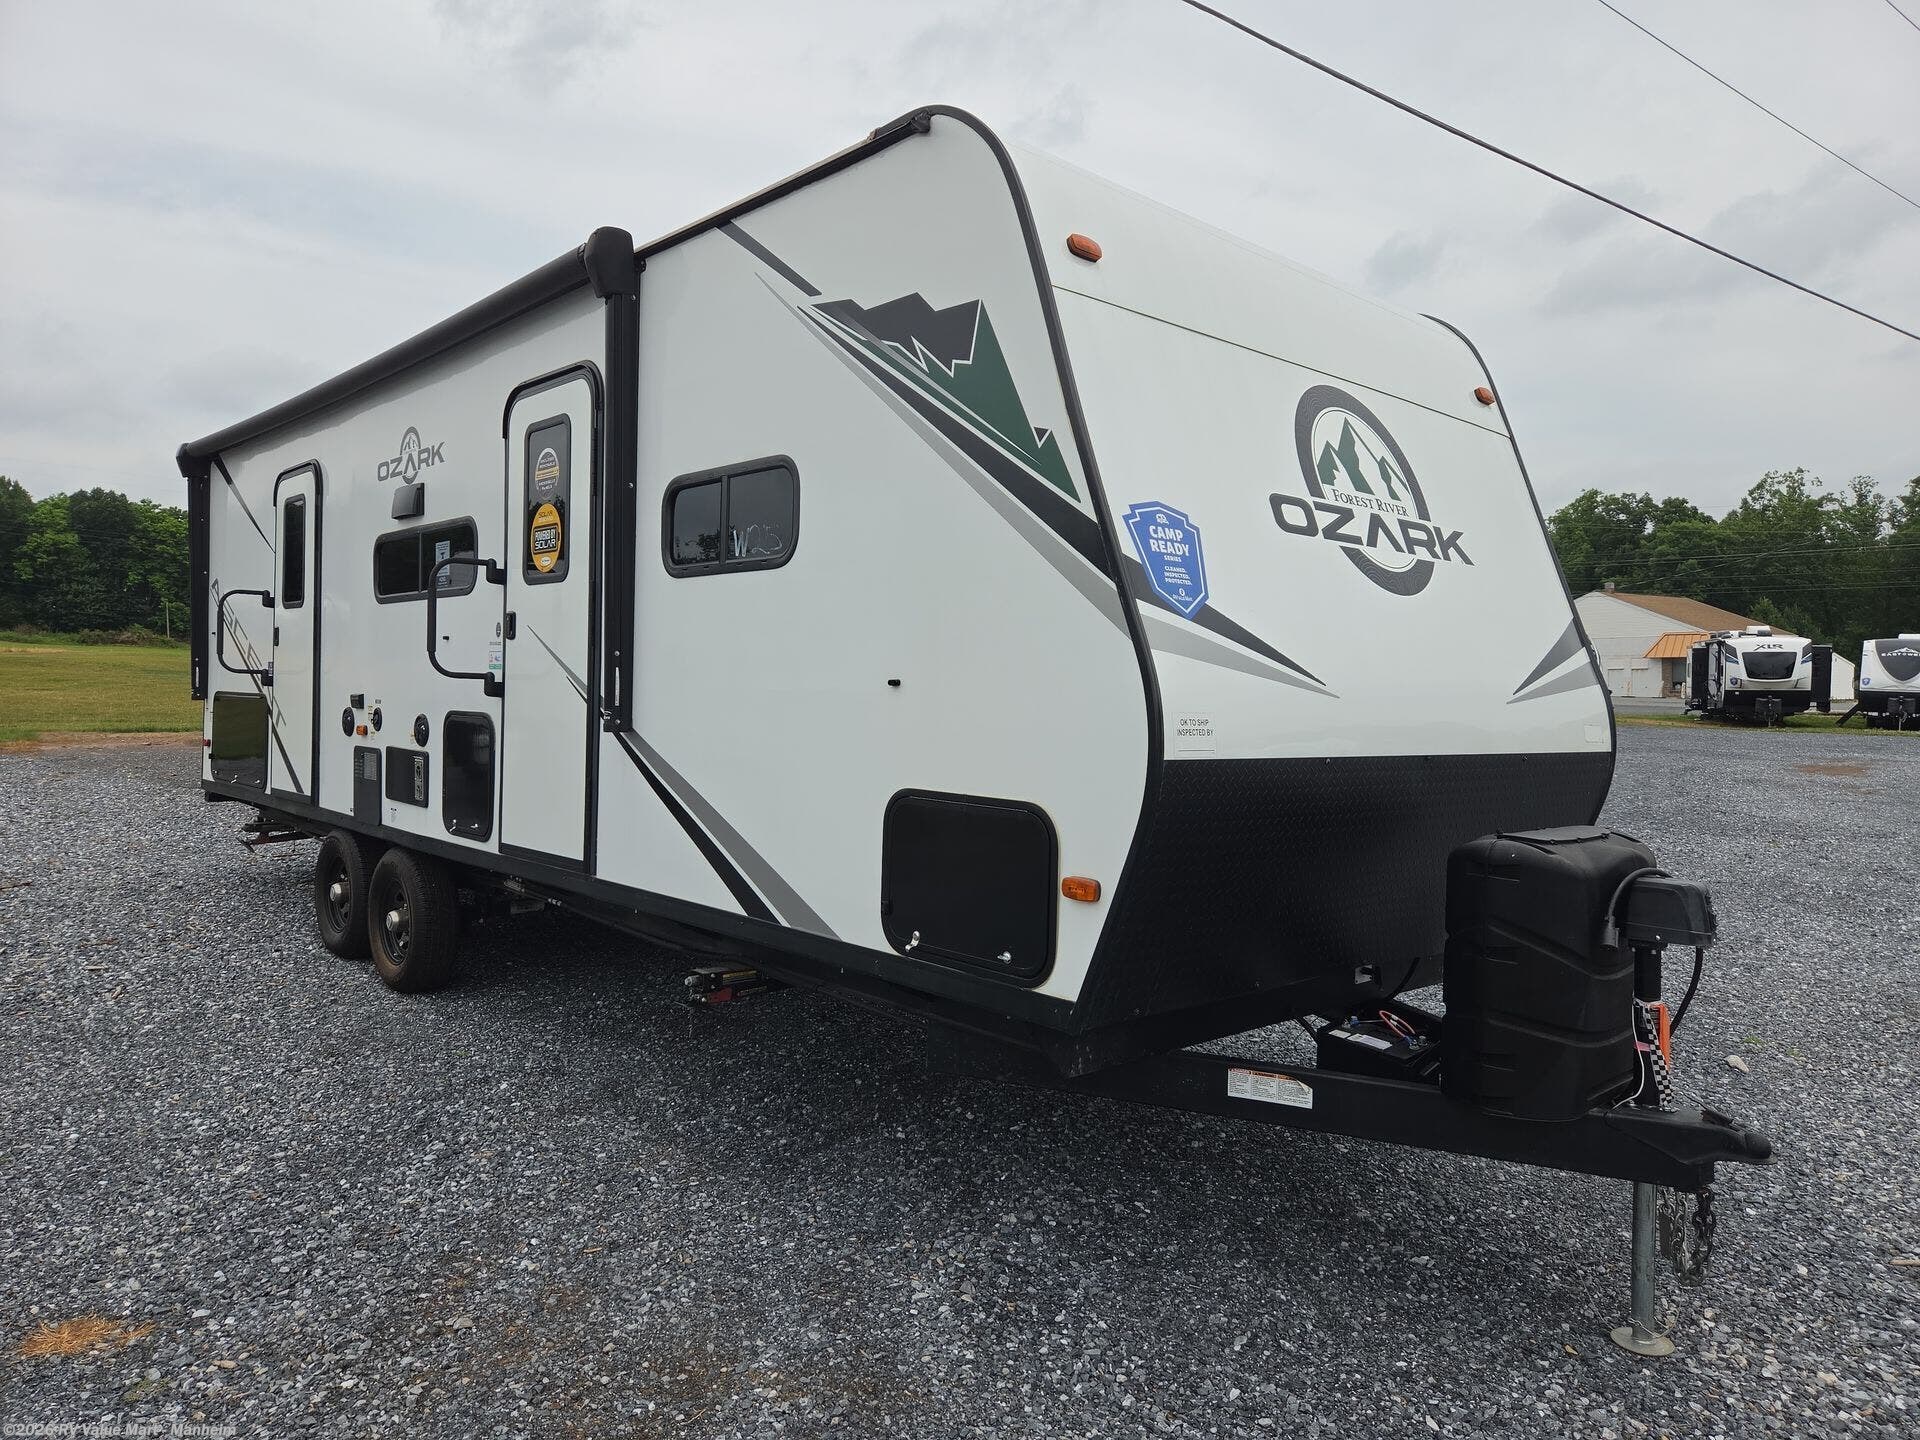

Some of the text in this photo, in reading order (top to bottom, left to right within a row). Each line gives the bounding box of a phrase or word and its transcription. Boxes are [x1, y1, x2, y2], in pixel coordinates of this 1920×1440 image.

[378, 441, 445, 481] OZARK
[1331, 488, 1410, 517] FOREST RIVER
[1149, 525, 1183, 541] CAMP
[1269, 493, 1475, 566] OZARK
[535, 538, 556, 549] SOLAR
[1150, 540, 1189, 556] READY
[1180, 718, 1188, 726] OK
[1189, 718, 1196, 726] TO
[1177, 728, 1205, 736] INSPECTED
